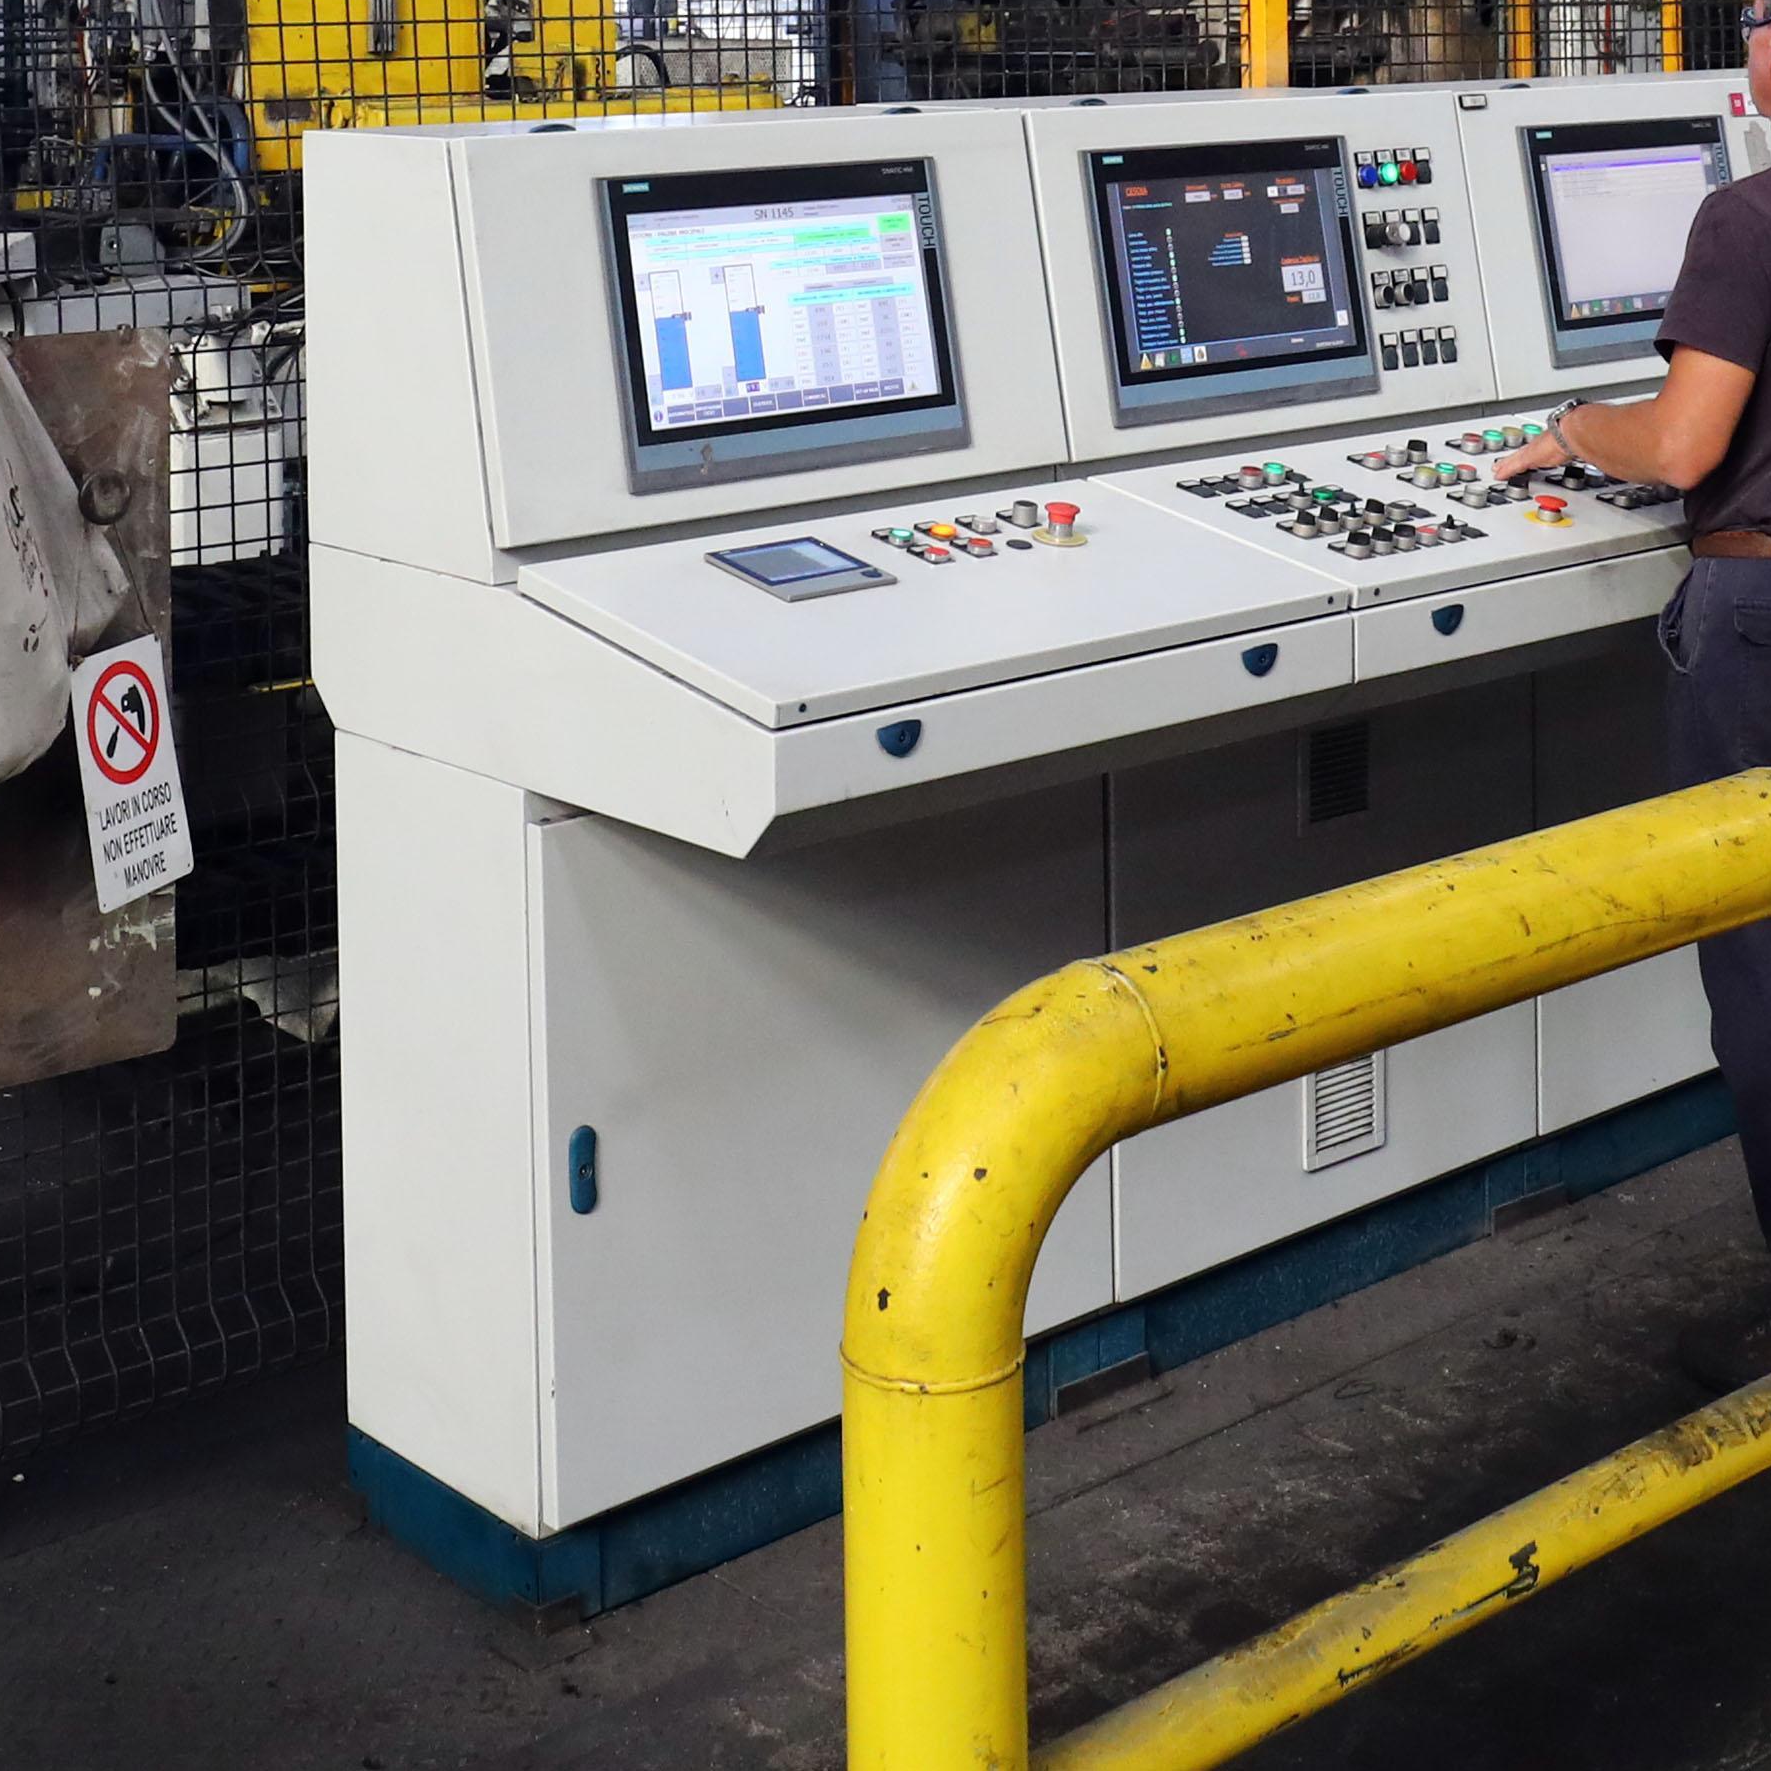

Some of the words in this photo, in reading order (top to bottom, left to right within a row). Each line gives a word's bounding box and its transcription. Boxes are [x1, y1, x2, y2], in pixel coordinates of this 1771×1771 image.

[770, 207, 795, 219] 1145
[1332, 169, 1349, 217] TOUCH
[917, 196, 936, 249] TOUCH
[99, 800, 130, 831] LAVORI
[130, 794, 142, 818] IN
[141, 781, 172, 813] CORSO
[103, 839, 124, 865] NON
[123, 812, 178, 855] EFFETTUARE
[124, 851, 167, 889] MANOVRE
